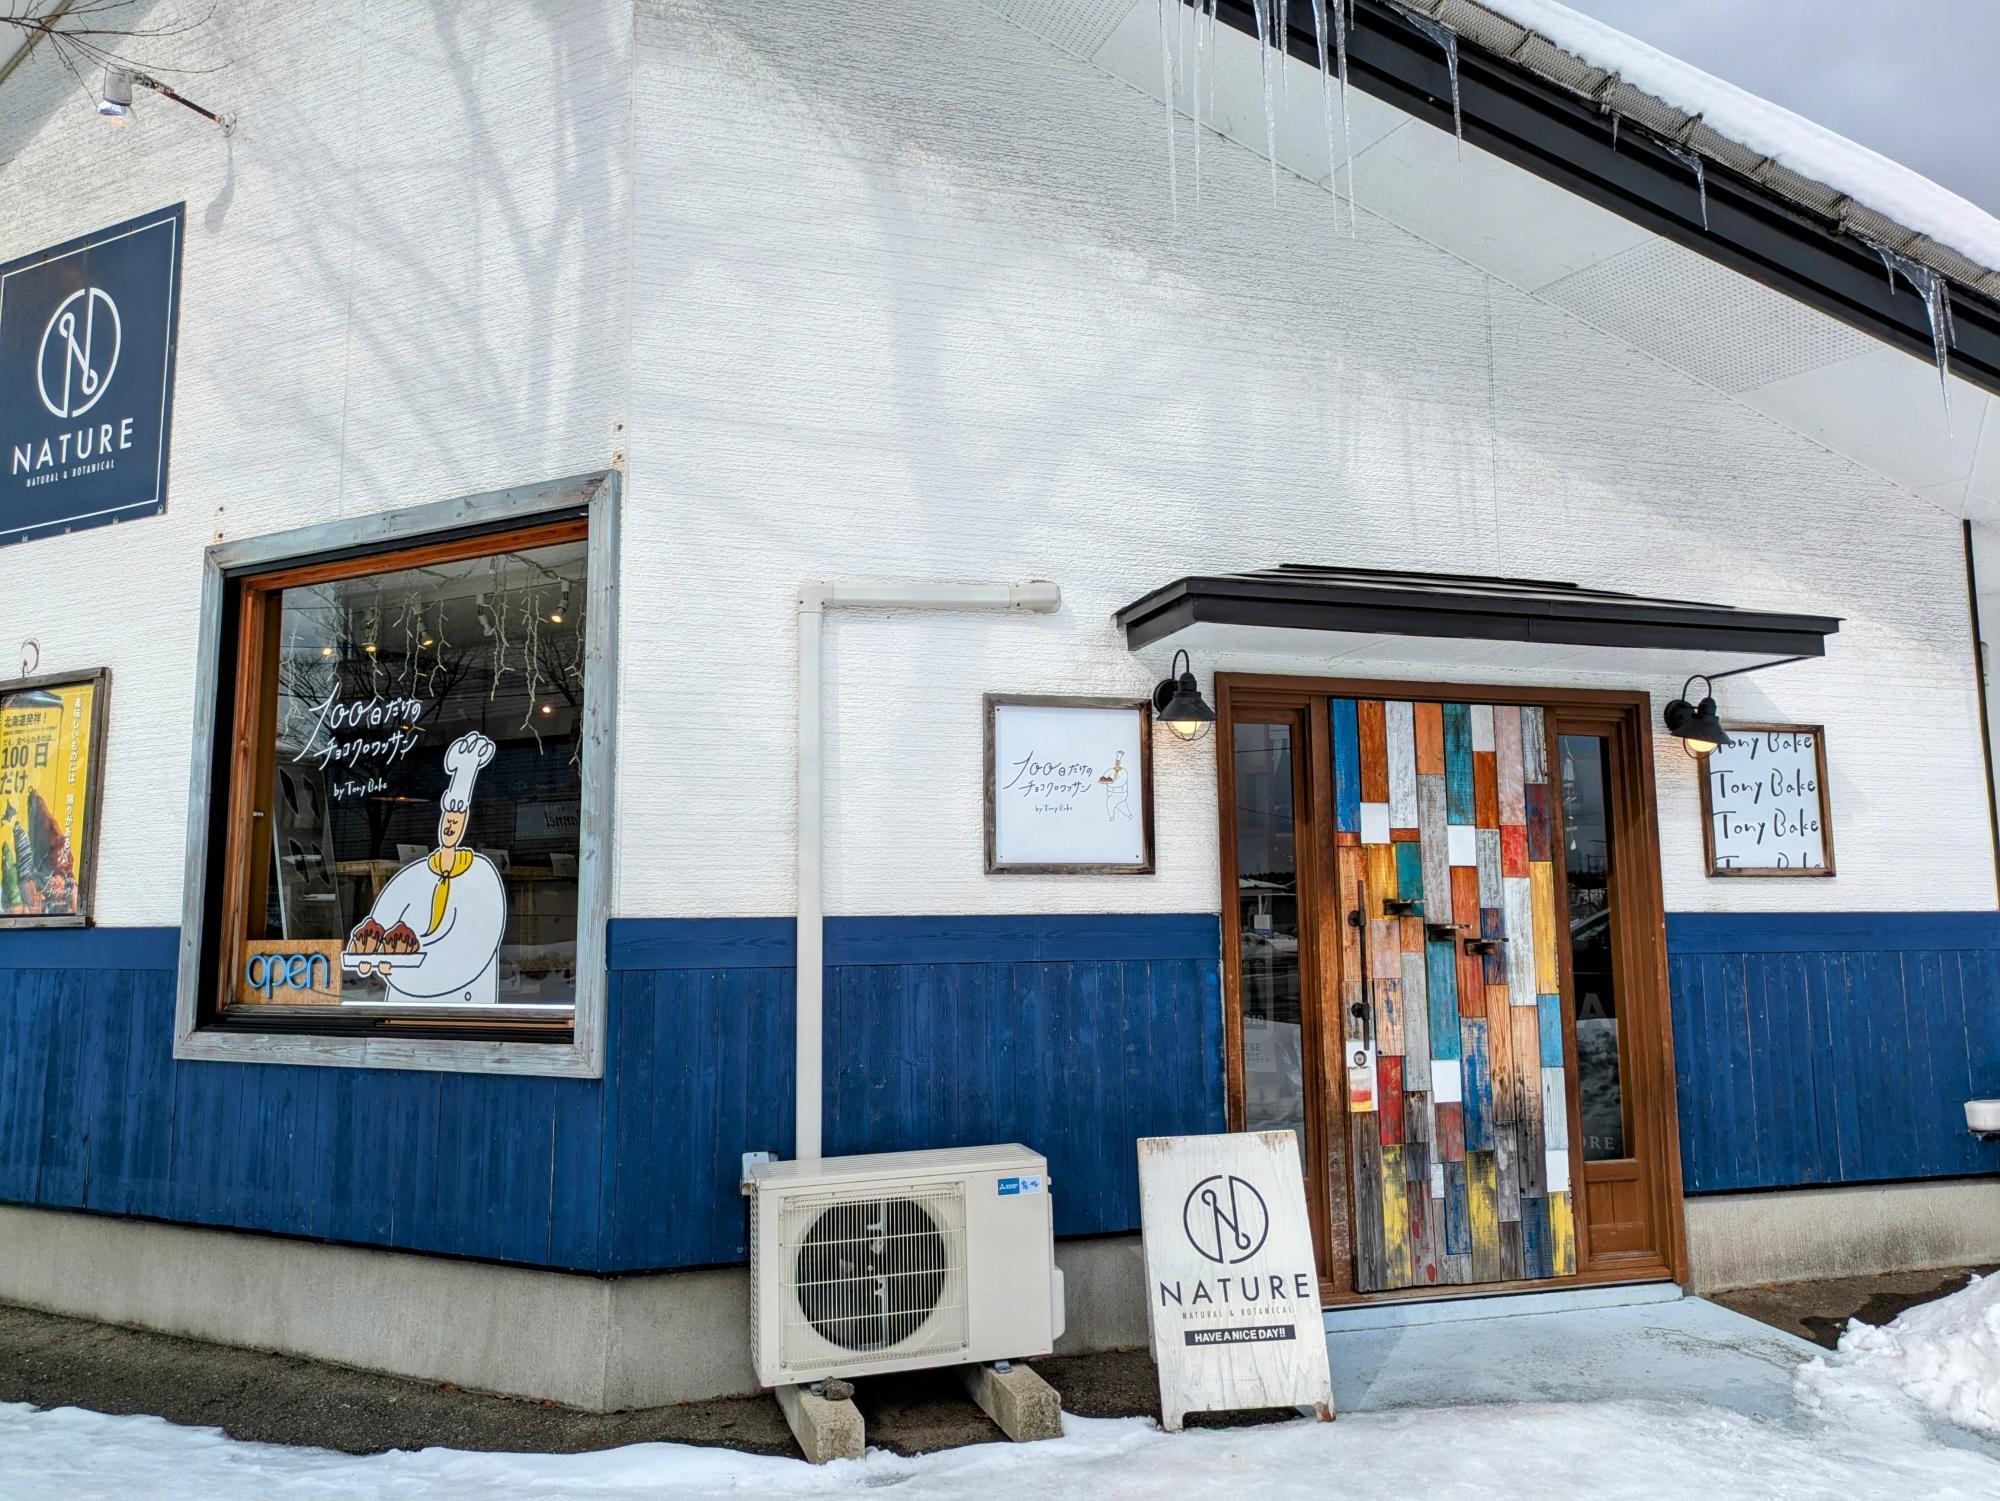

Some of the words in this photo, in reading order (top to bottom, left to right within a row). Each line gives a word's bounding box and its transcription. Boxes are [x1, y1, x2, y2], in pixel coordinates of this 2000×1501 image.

[12, 417, 134, 475] NATURE
[26, 472, 59, 488] NATURAL
[63, 470, 68, 479] &
[72, 459, 115, 478] BOTANICAL
[313, 730, 418, 771] チョコクロワッサン
[1768, 732, 1812, 753] Bake
[333, 783, 344, 800] by
[345, 781, 366, 797] Tony
[1018, 780, 1092, 798] チョコクロワッサン
[1711, 770, 1763, 804] Tony
[1771, 768, 1816, 797] Bake
[1713, 811, 1765, 845] Tony
[1774, 808, 1819, 837] Bake
[246, 953, 329, 999] open
[1160, 1273, 1311, 1307] NATURE
[1182, 1310, 1223, 1319] NATURAL
[1241, 1305, 1293, 1316] BOTANICAL
[1194, 1331, 1223, 1343] HAVE
[1223, 1332, 1231, 1340] A
[1232, 1329, 1257, 1340] NICE
[1258, 1327, 1286, 1339] DAY!!
